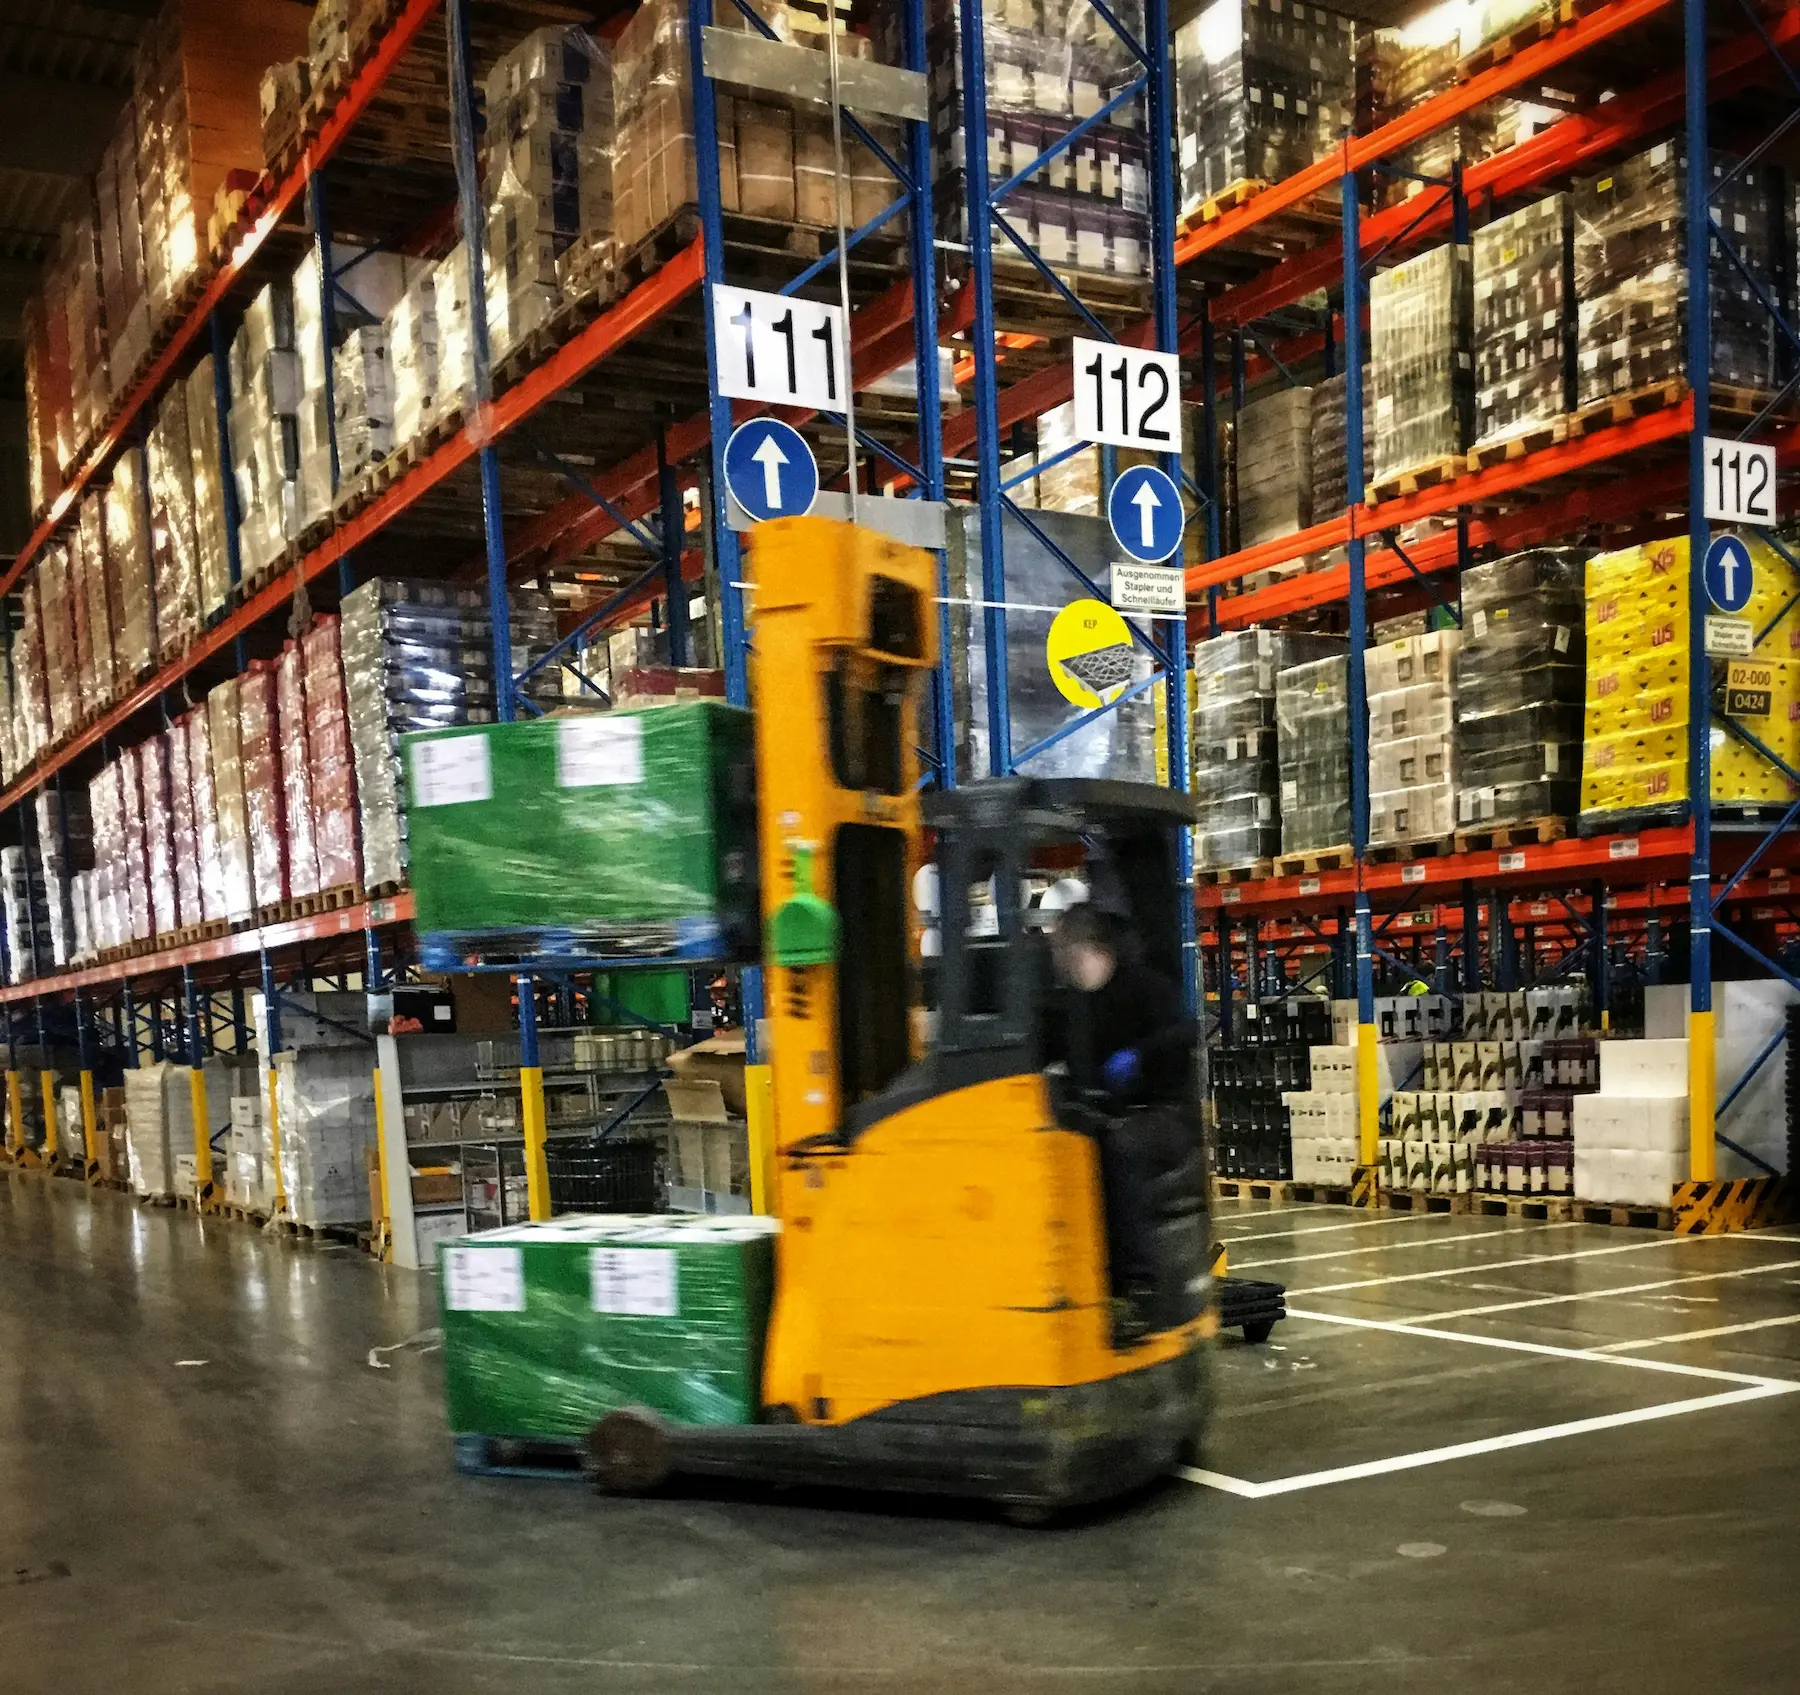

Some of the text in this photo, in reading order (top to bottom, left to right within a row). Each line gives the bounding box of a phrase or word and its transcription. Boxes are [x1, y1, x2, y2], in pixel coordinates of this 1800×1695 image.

[730, 301, 837, 401] 111
[1086, 353, 1171, 441] 112
[1711, 448, 1769, 517] 112
[1116, 568, 1180, 582] Ausgenommen
[1124, 581, 1173, 594] Stapler und
[1083, 619, 1098, 630] KEP
[1732, 668, 1771, 686] 02-000
